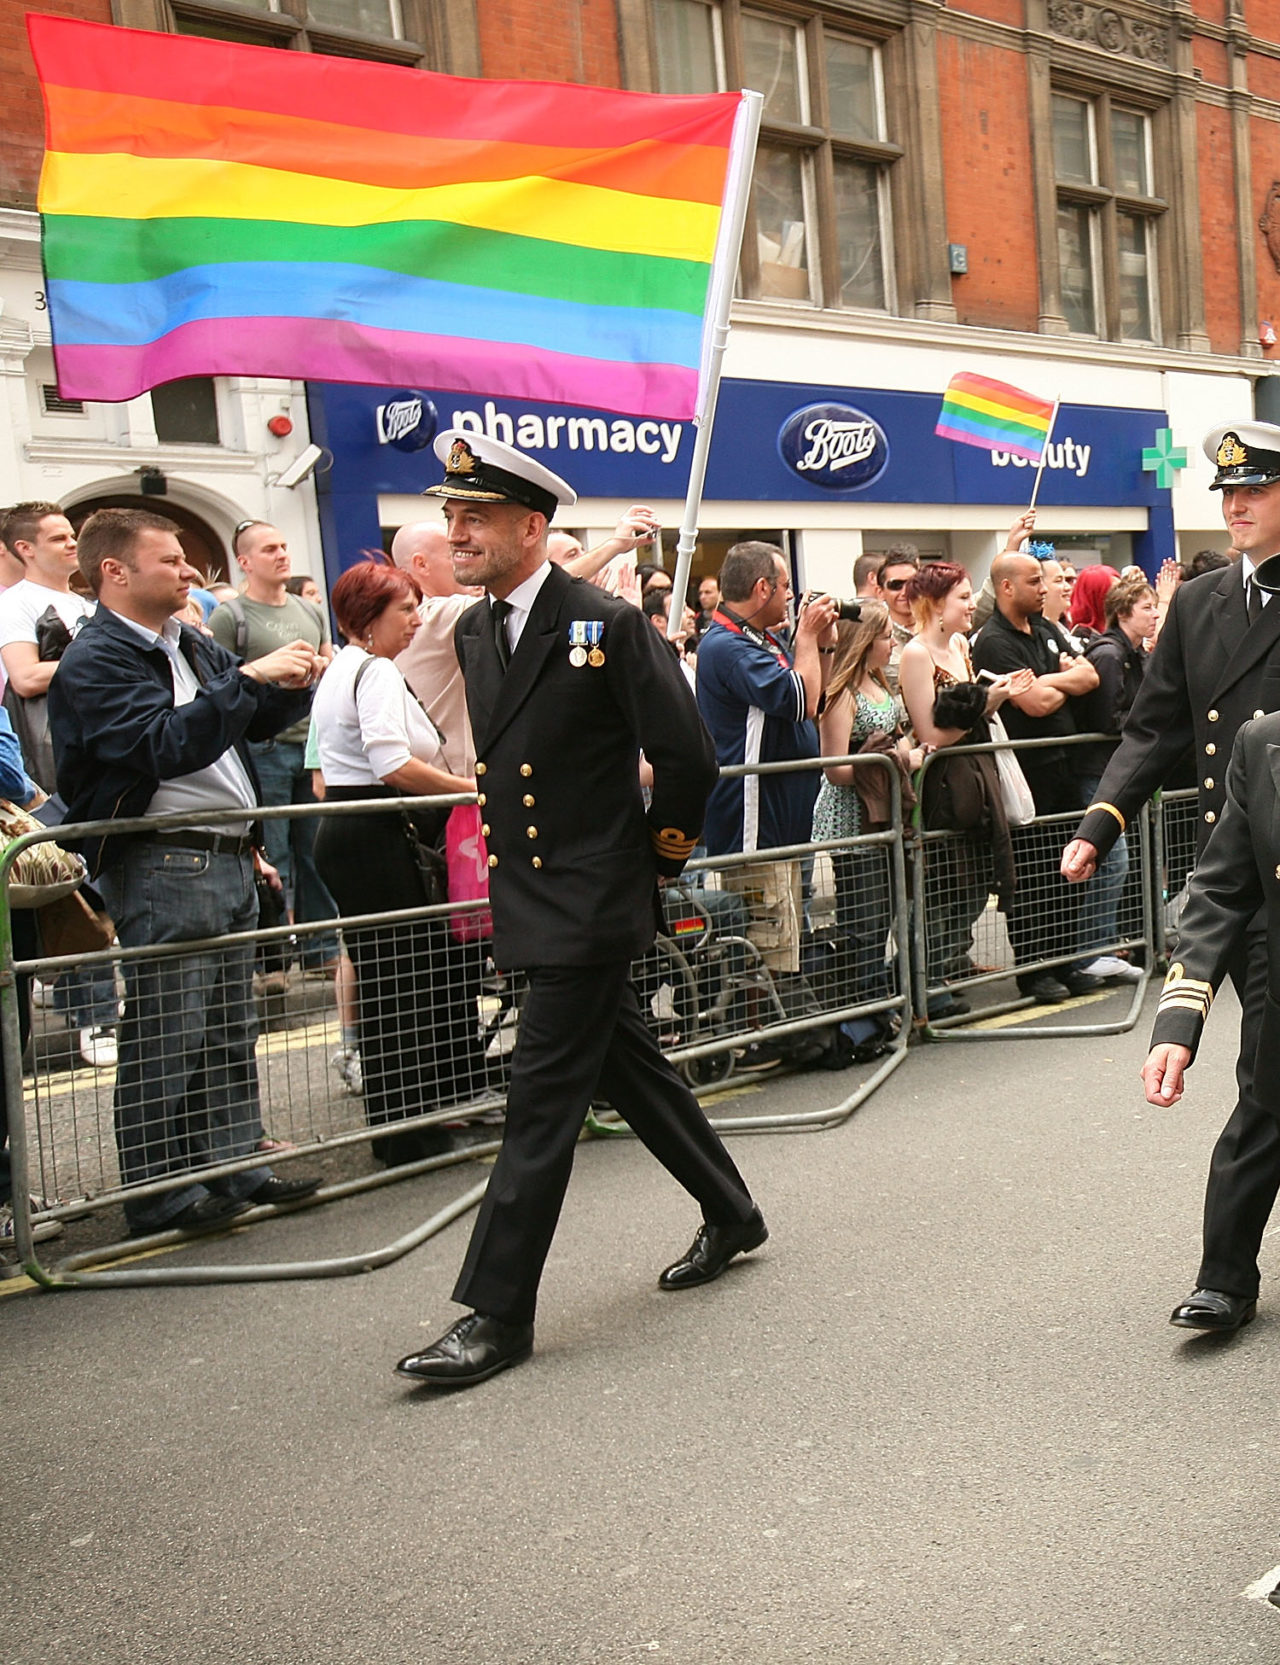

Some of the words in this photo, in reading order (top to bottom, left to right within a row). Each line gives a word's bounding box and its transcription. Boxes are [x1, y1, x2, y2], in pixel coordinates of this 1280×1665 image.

[453, 401, 683, 463] pharmacy
[796, 418, 877, 472] Boots
[991, 436, 1091, 477] uty
